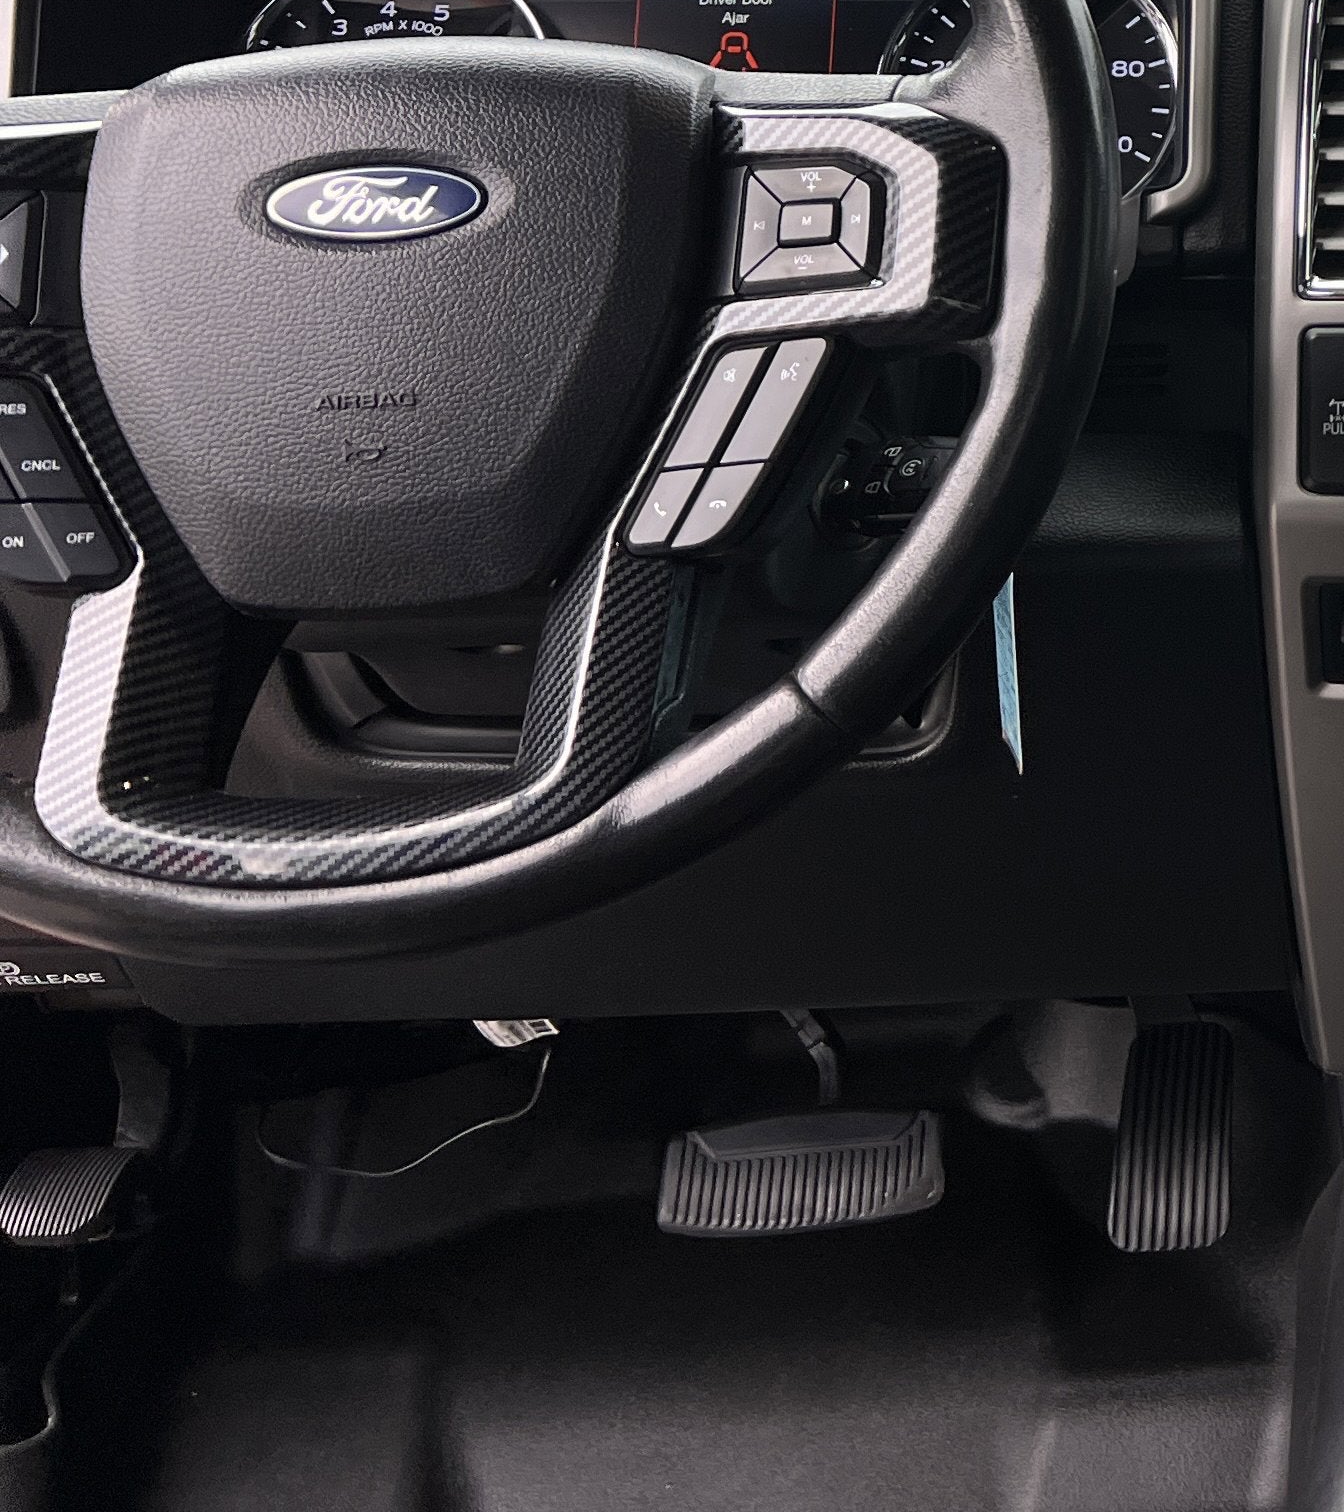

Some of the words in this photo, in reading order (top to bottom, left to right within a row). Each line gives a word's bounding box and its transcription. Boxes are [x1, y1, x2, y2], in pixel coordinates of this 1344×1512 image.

[380, 0, 397, 18] 4
[434, 4, 450, 21] 5
[721, 11, 750, 26] Ajar
[332, 18, 348, 36] 3
[364, 21, 393, 37] RPM
[411, 20, 443, 37] 1000
[1110, 60, 1146, 78] 80
[800, 171, 822, 182] VOL
[307, 175, 439, 226] Ford
[801, 215, 812, 226] M
[793, 254, 815, 265] VOL
[0, 403, 26, 415] RES
[21, 459, 61, 472] CNCL
[2, 535, 24, 548] ON
[66, 531, 95, 545] OFF
[4, 972, 106, 986] RELEASE
